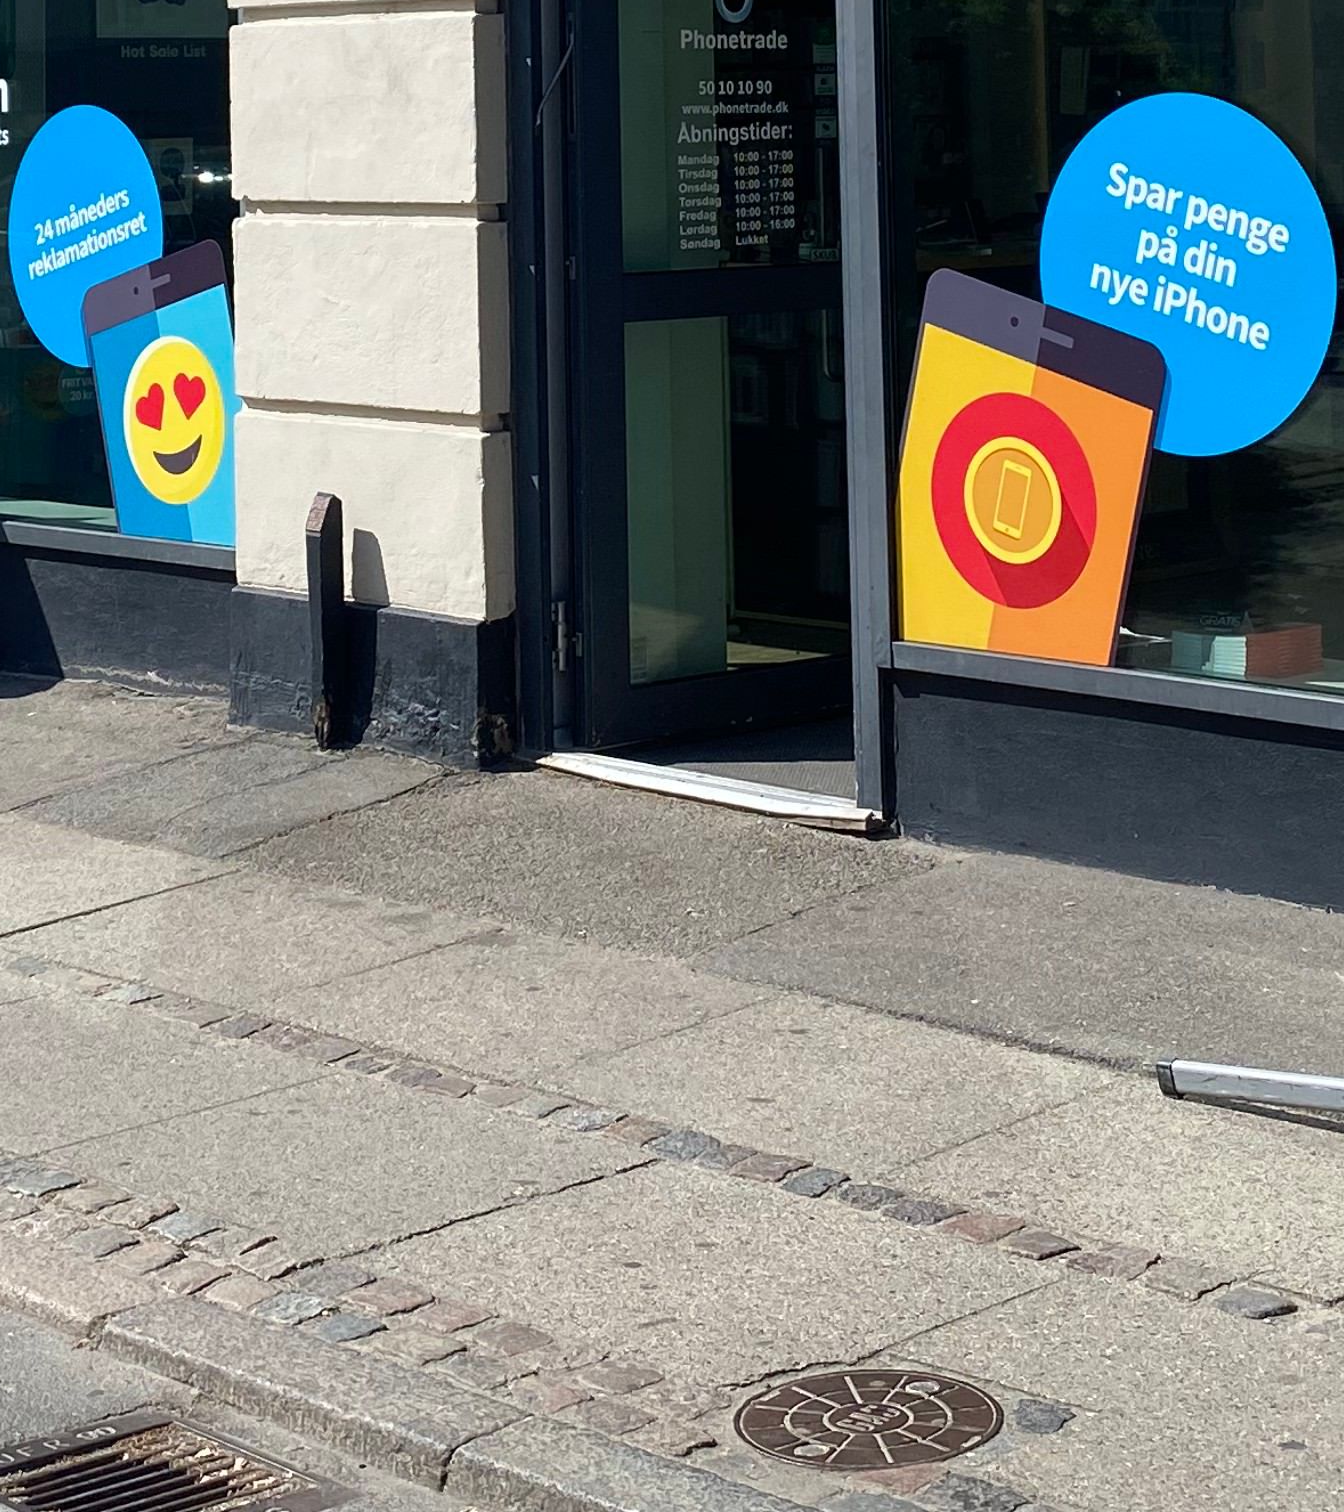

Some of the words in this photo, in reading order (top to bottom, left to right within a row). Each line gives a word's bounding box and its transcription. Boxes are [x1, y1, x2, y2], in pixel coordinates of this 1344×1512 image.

[680, 29, 788, 50] Phonetrade
[120, 44, 145, 58] Hot
[183, 44, 207, 58] List
[698, 80, 715, 96] 50
[718, 80, 735, 95] 10
[737, 80, 754, 95] 10
[756, 79, 773, 95] 90
[681, 101, 789, 117] www.phonetrade.dk
[677, 121, 793, 146] Åbningstider:
[677, 154, 720, 166] Mandag
[733, 151, 760, 162] 10:00
[767, 149, 794, 161] 17:00
[678, 168, 718, 180] Tirsdag
[734, 165, 760, 176] 10:00
[768, 163, 794, 175] 17:00
[678, 182, 720, 194] Onsdag
[734, 179, 760, 190] 10:00
[768, 177, 794, 189] 17:00
[678, 196, 721, 208] Torsdag
[735, 193, 761, 204] 10:00
[769, 191, 795, 202] 17:00
[34, 218, 55, 245] 24
[54, 189, 130, 237] måneders
[679, 210, 717, 222] Fredag
[736, 206, 761, 218] 10:00
[769, 205, 795, 216] 17:00
[1105, 162, 1184, 215] Spar
[1184, 194, 1290, 255] penge
[679, 224, 718, 236] Lørdag
[736, 220, 761, 232] 10:00
[770, 218, 796, 230] 16:00
[28, 211, 148, 280] reklamationsret
[679, 238, 721, 250] Søndag
[735, 234, 769, 246] Lukket
[1135, 225, 1179, 267] på
[1183, 239, 1237, 288] din
[1089, 263, 1149, 306] nye
[1153, 275, 1270, 351] iPhone
